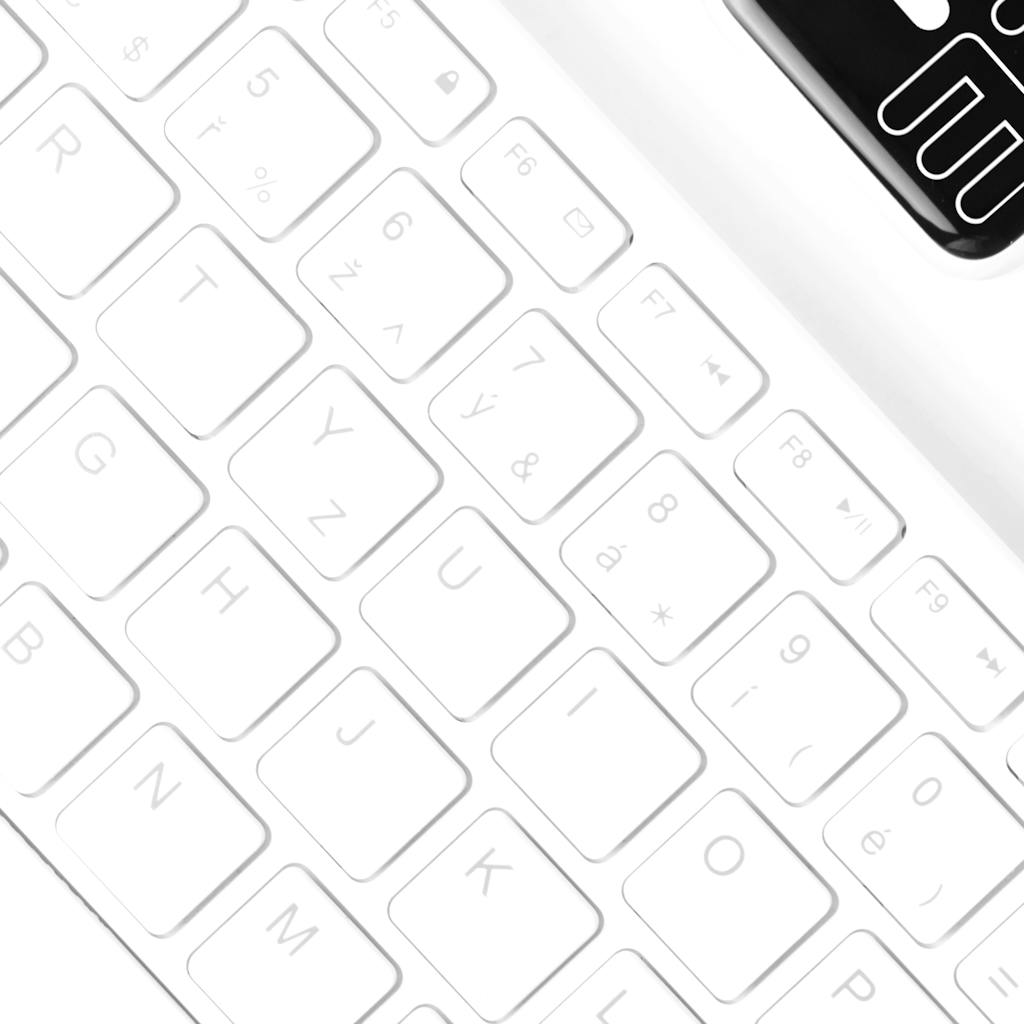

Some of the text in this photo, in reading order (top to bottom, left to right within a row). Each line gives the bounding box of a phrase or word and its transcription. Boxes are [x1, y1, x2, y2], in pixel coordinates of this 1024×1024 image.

[122, 35, 150, 63] $
[245, 66, 281, 99] 5
[35, 122, 83, 175] R
[503, 141, 538, 177] F6
[247, 166, 277, 204] %
[381, 210, 414, 242] 6
[178, 263, 219, 304] T
[639, 287, 677, 320] F7
[511, 344, 547, 372] 7
[312, 405, 355, 447] Y
[74, 431, 117, 476] G
[509, 451, 540, 485] &
[778, 433, 813, 470] F8
[306, 498, 348, 538] Z
[647, 492, 679, 524] 8
[436, 544, 484, 591] U
[199, 565, 250, 615] H
[914, 578, 950, 614] F9
[0, 620, 45, 665] B
[778, 633, 812, 665] 9
[335, 719, 377, 747] J
[132, 760, 183, 811] N
[463, 847, 515, 898] K
[703, 834, 746, 877] O
[264, 901, 320, 958] M
[829, 968, 877, 1003] P
